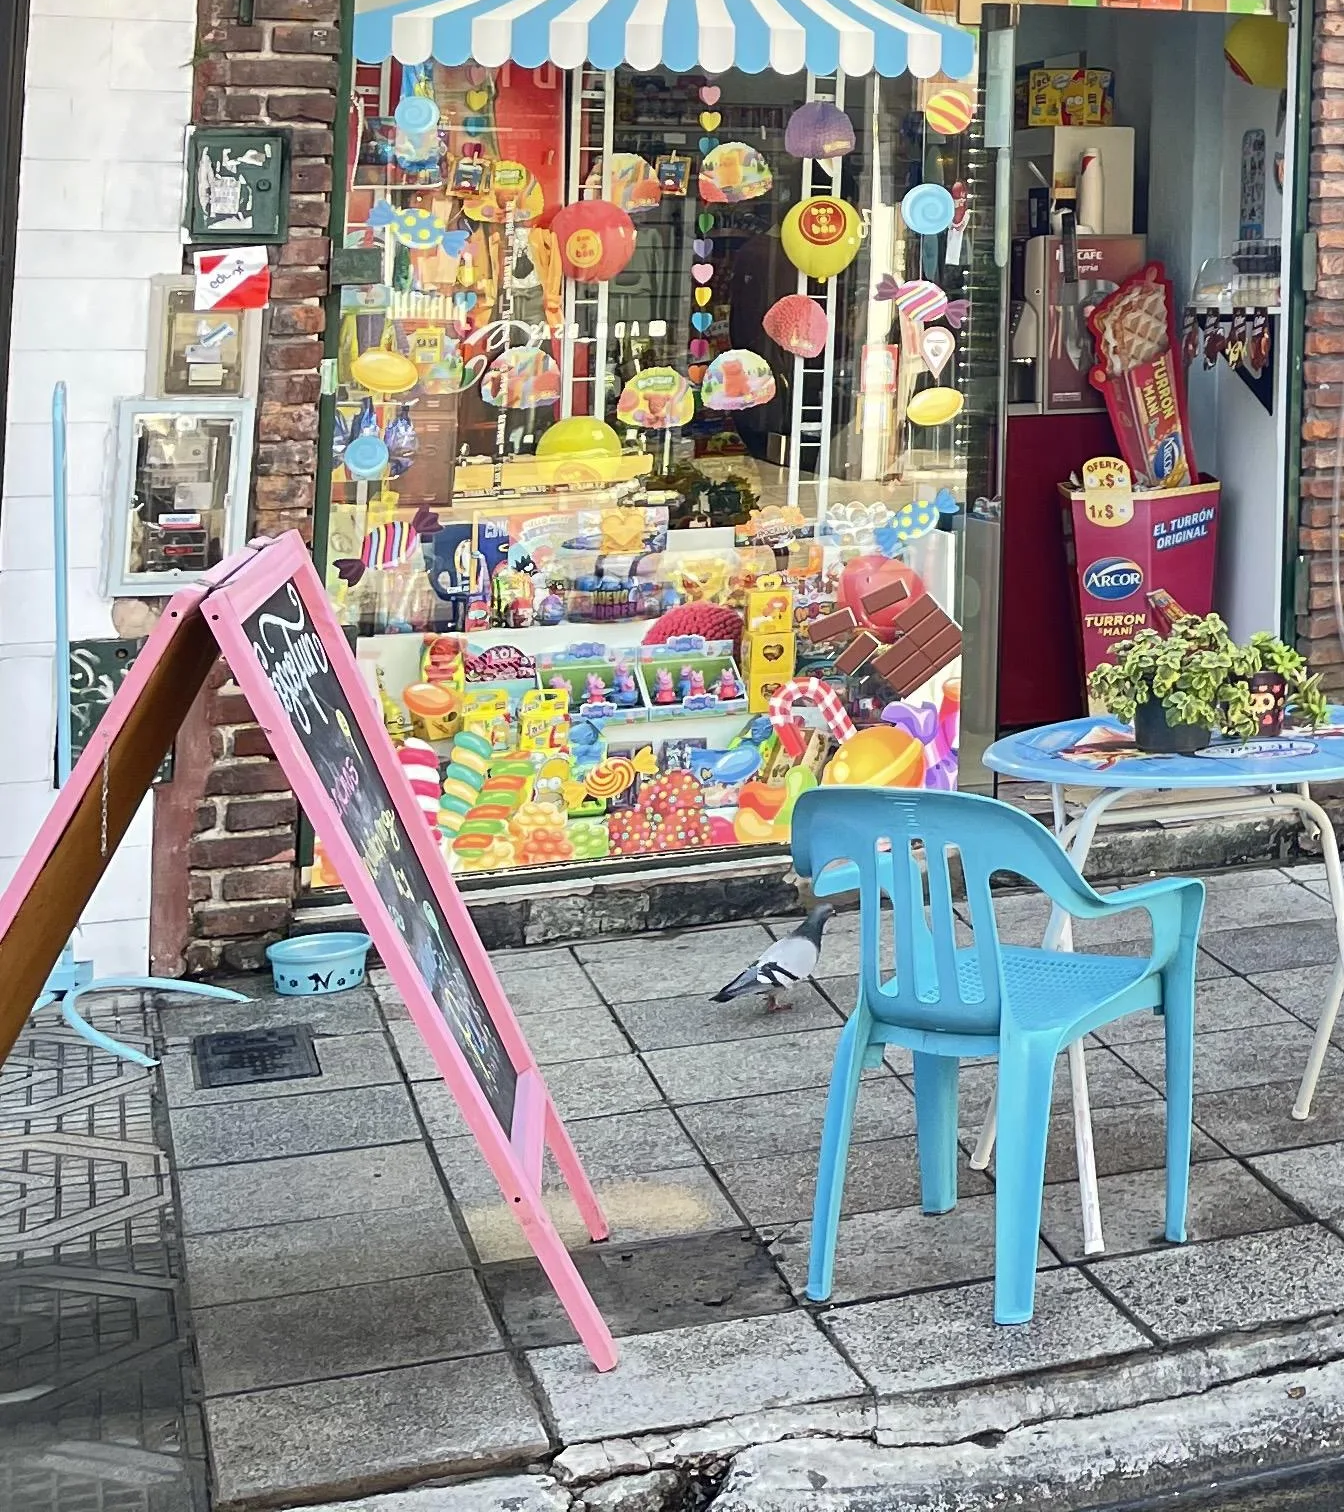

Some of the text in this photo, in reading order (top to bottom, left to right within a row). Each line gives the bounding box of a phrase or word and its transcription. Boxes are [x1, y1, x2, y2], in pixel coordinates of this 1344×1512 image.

[1086, 460, 1125, 474] OFERTA
[1152, 523, 1167, 537] EL
[1155, 524, 1208, 551] ORIGINAL
[1086, 571, 1142, 589] ARCOR
